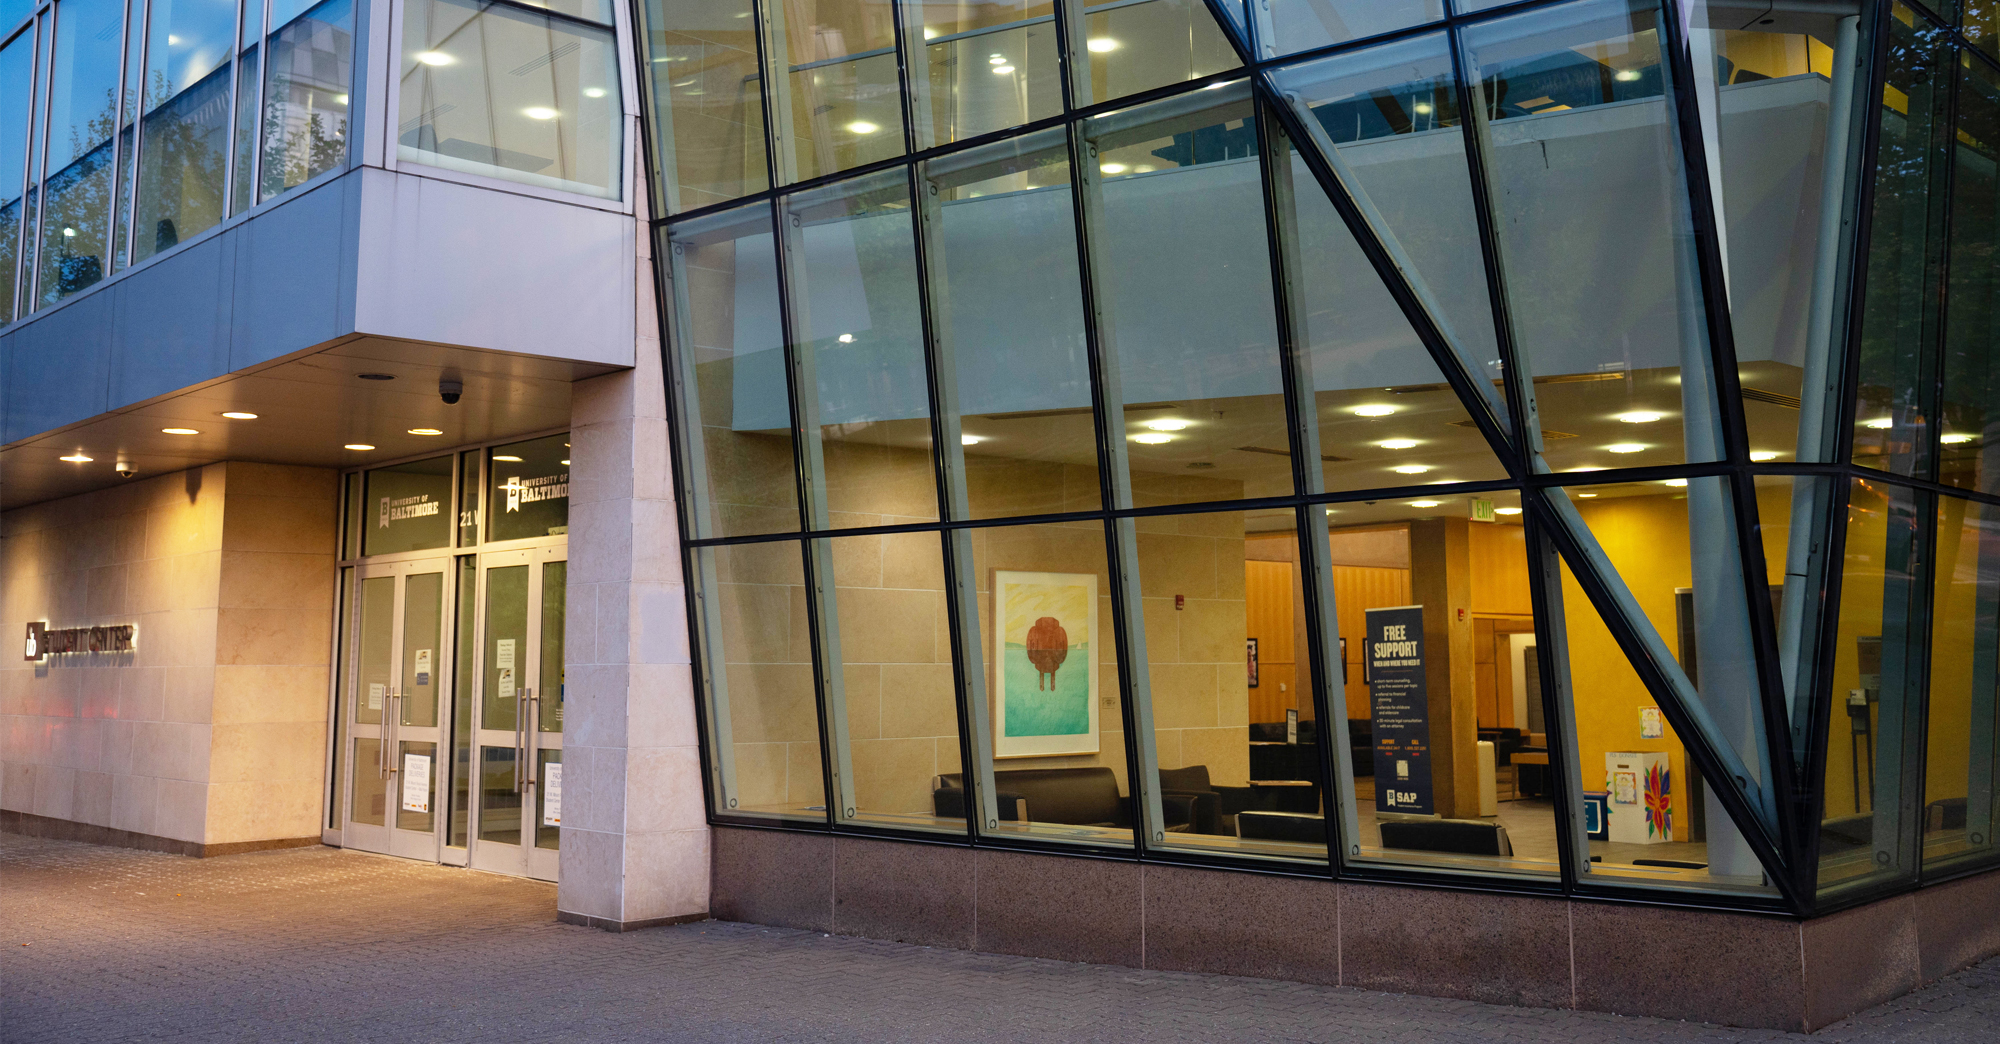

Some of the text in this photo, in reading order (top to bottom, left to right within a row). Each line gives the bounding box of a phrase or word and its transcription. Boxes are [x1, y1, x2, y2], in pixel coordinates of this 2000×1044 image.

[521, 473, 568, 487] UNIVERSITY OF
[391, 494, 429, 507] UNIVERSITY OF
[520, 483, 569, 503] BALTIMO
[391, 501, 439, 520] BALTIMORE
[1476, 500, 1491, 519] EXIT
[460, 511, 472, 527] 21
[1383, 625, 1407, 641] FREE
[1374, 641, 1418, 658] SUPPORT
[1396, 792, 1417, 803] SAP
